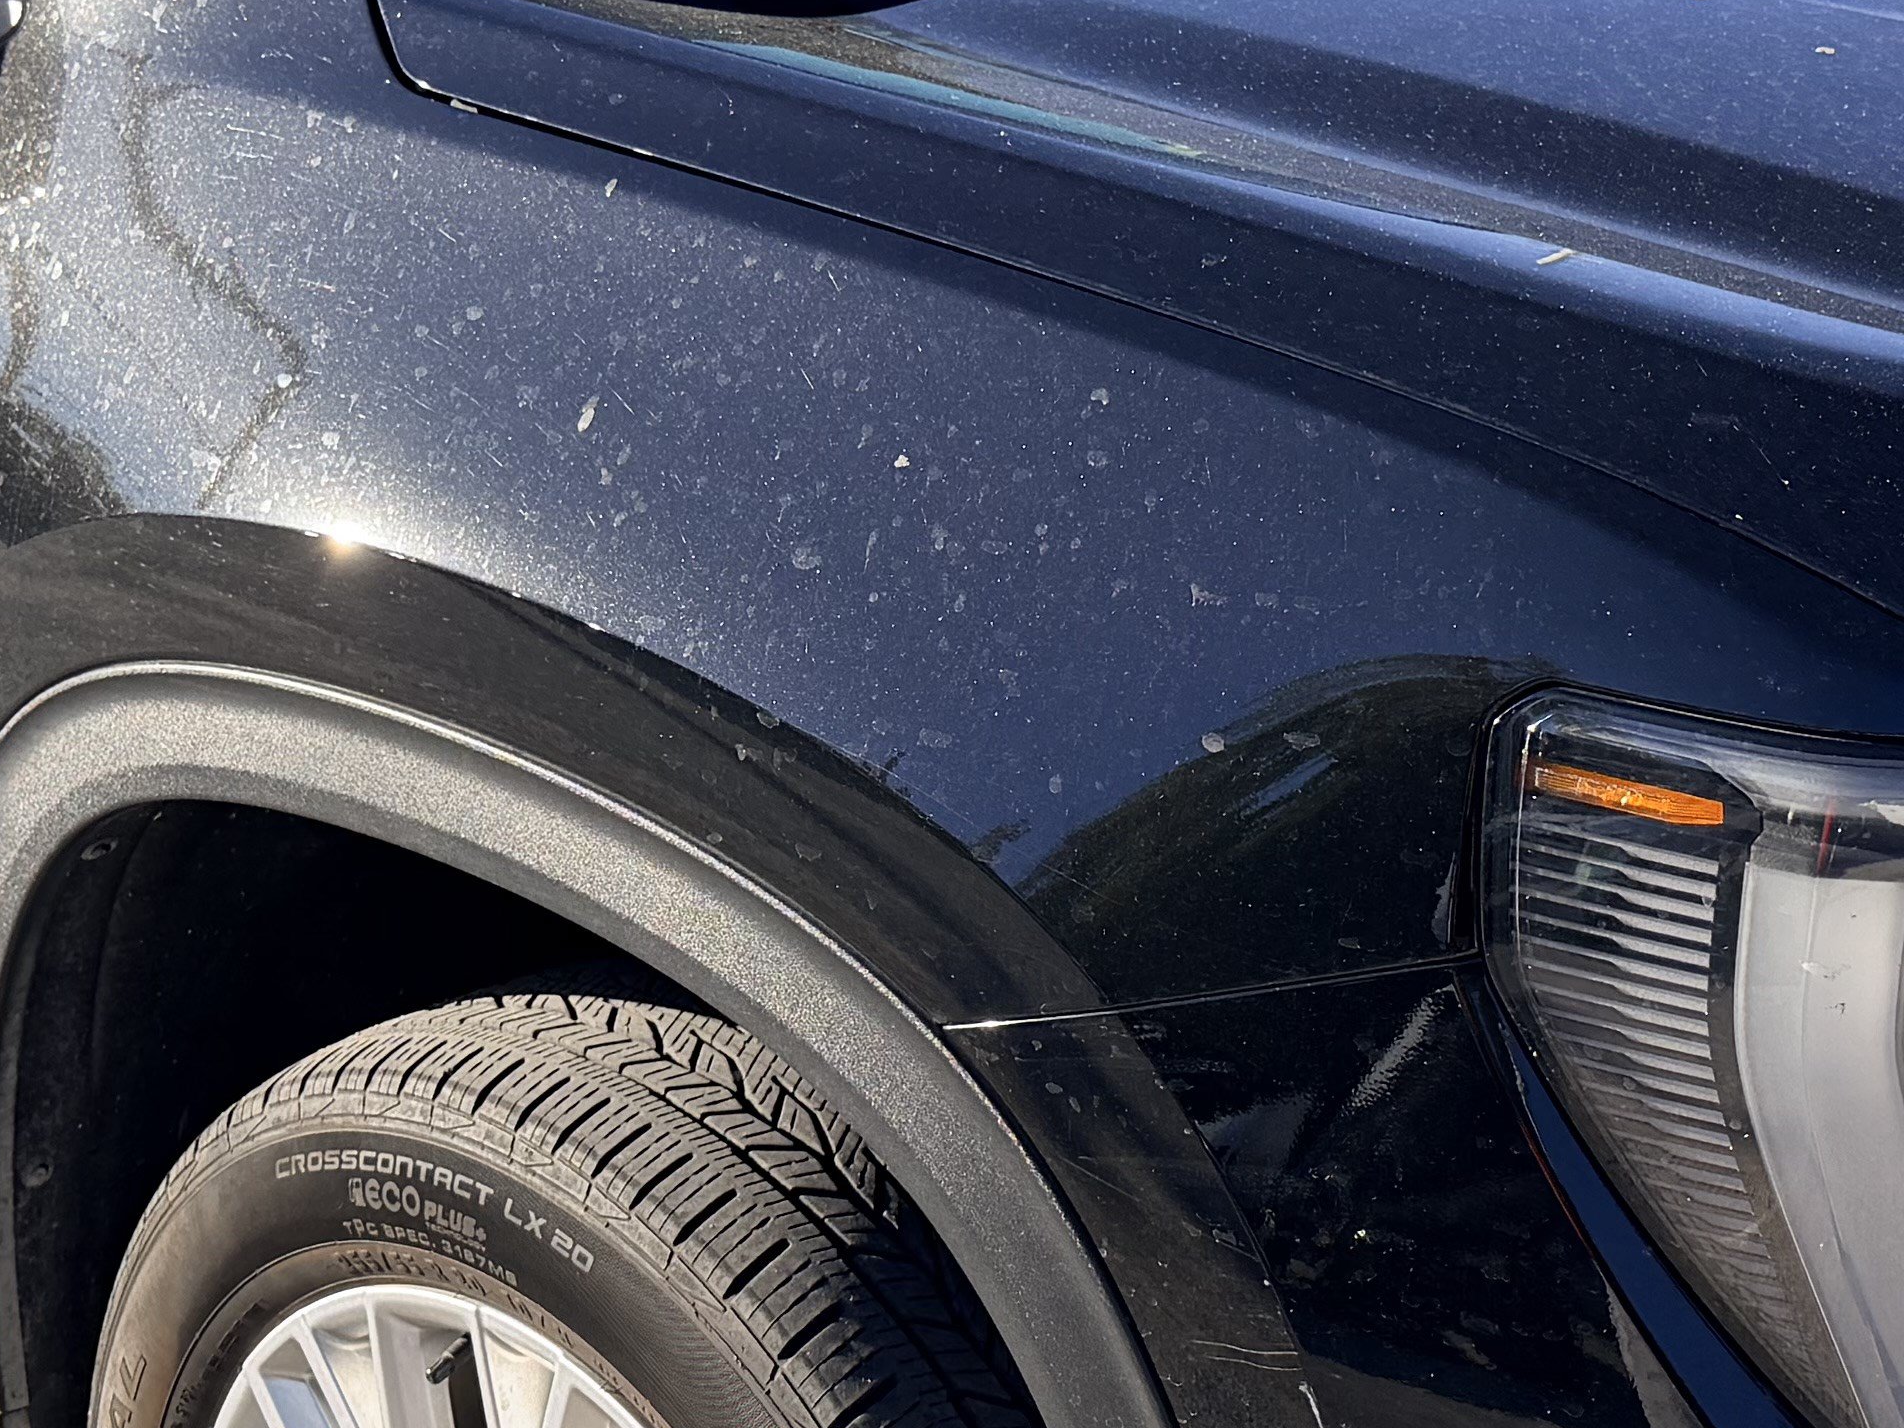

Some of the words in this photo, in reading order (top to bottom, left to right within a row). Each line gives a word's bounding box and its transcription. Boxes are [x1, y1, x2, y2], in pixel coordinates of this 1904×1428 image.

[275, 1149, 494, 1206] CROSSCONTACT
[503, 1198, 546, 1239] LX
[550, 1228, 595, 1273] 20
[343, 1220, 378, 1238] TPC
